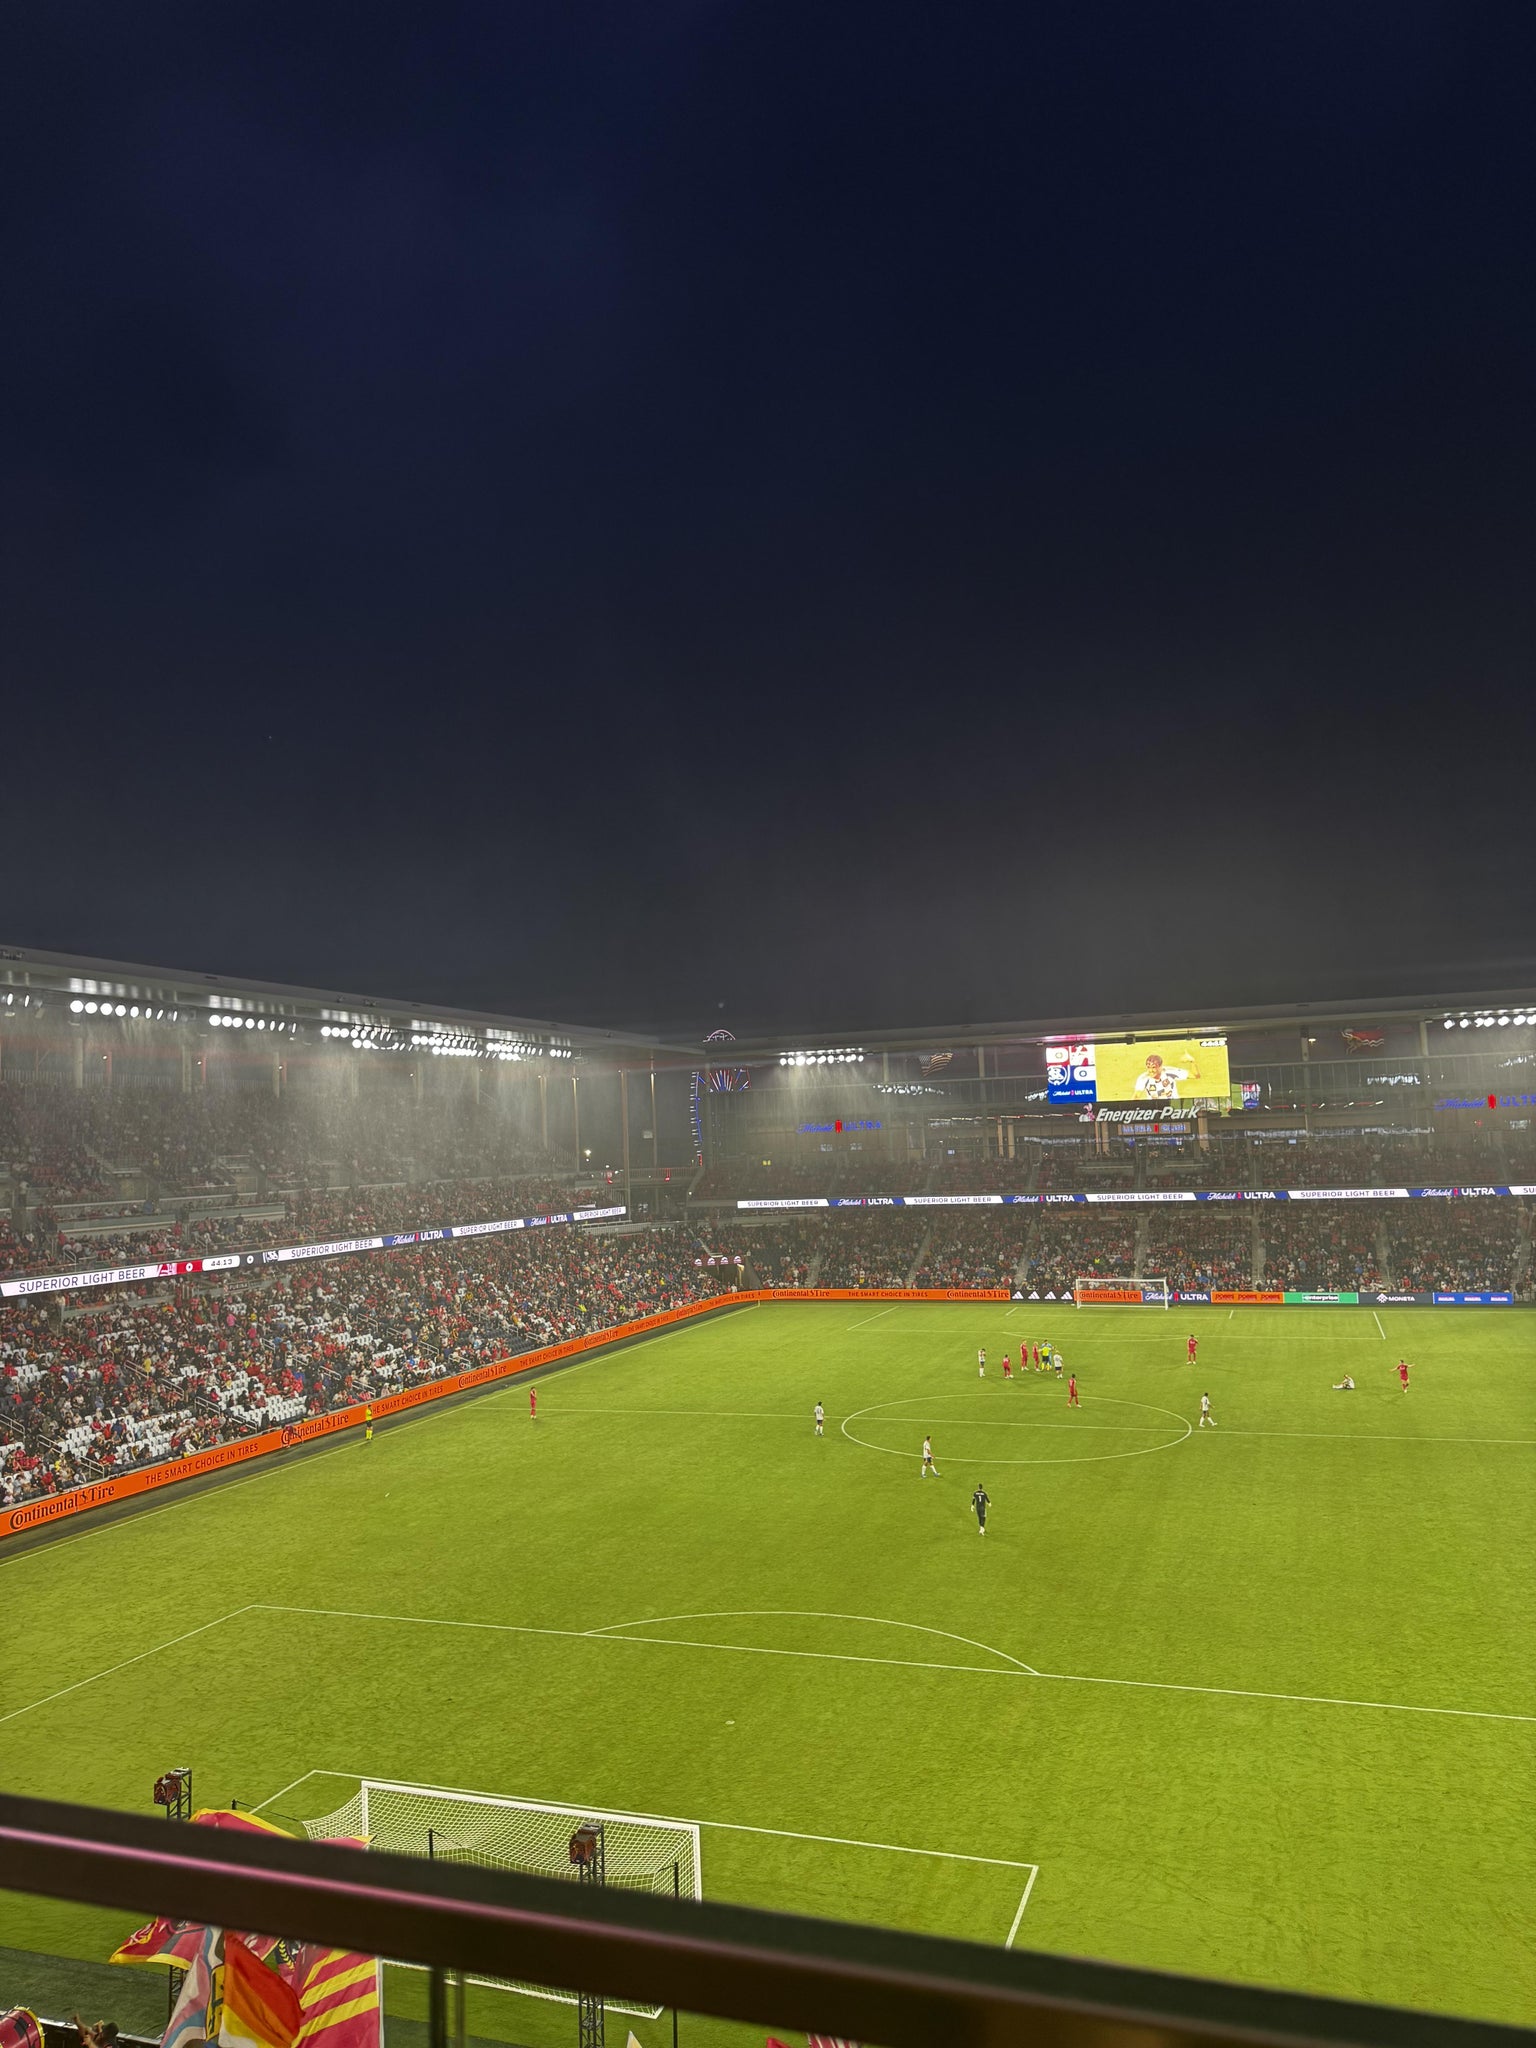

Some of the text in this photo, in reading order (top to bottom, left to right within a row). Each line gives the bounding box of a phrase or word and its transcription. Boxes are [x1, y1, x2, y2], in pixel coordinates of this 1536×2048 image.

[1096, 1106, 1200, 1123] Energizer Park
[1244, 1191, 1276, 1200] ULTRA
[1461, 1187, 1496, 1196] ULTRA
[1046, 1194, 1075, 1202] ULTRA
[550, 1214, 567, 1223] ULTRA
[579, 1210, 599, 1219] SUPERIOR
[600, 1208, 611, 1217] LIGHT
[460, 1220, 517, 1235] SUPERIOR LIGHT BEER
[420, 1230, 443, 1241] ULTRA
[291, 1239, 373, 1258] SUPERIOR LIGHT BEER
[247, 1255, 254, 1264] 0
[186, 1263, 193, 1272] 0
[19, 1268, 145, 1292] SUPERIOR LIGHT BEER
[772, 1289, 830, 1298] Continental Tire
[947, 1290, 1009, 1299] Continental Tire
[1079, 1291, 1138, 1299] Continental Tire
[543, 1349, 558, 1360] CHOICE
[458, 1364, 507, 1388] Continental Tire
[372, 1385, 443, 1415] HE SMART CHOICE IN TIRES
[330, 1413, 349, 1427] Tire
[145, 1443, 259, 1485] THE SMART CHOICE IN TIRES
[9, 1485, 115, 1530] Continental Tire
